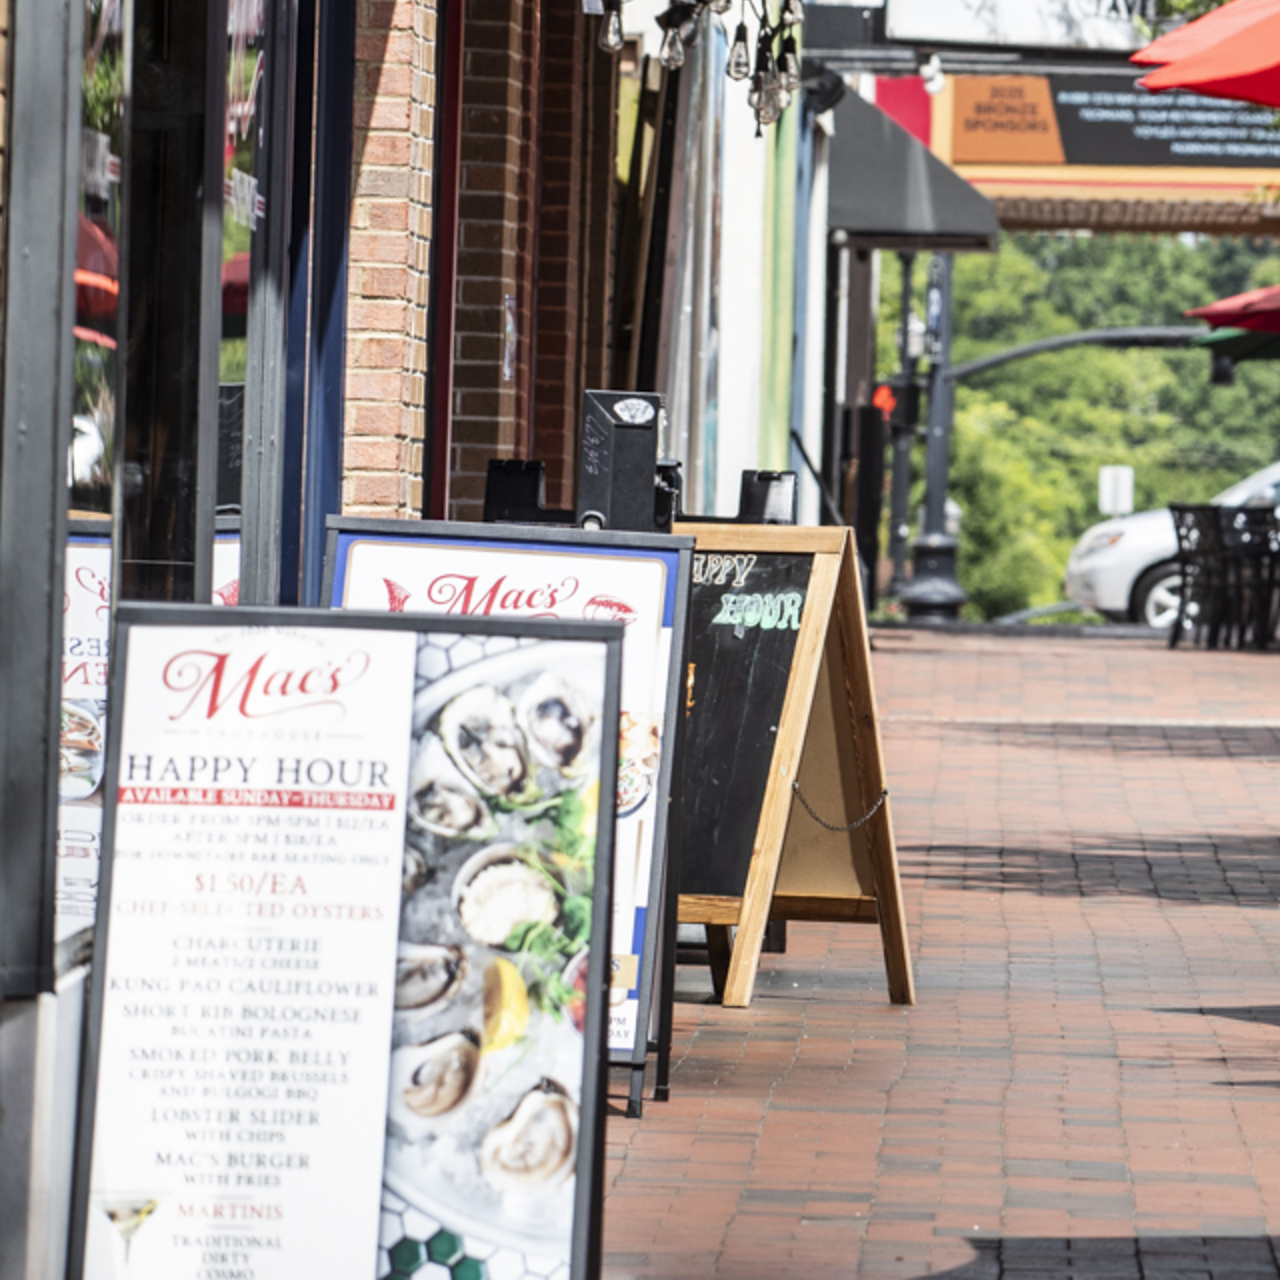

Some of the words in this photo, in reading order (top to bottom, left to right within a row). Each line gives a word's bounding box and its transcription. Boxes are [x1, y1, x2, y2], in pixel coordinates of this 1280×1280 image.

[974, 102, 1039, 117] BRONZE
[964, 118, 1050, 134] SPONSORS
[712, 591, 802, 630] HOUR
[163, 649, 371, 721] Mac's
[127, 754, 257, 784] HAPPY
[276, 757, 390, 788] HOUR
[122, 788, 217, 804] AVAILABLE
[190, 813, 240, 827] FROM
[172, 832, 228, 845] AFTER
[195, 873, 308, 896] $1.50/EA
[291, 902, 385, 919] OYSTERS
[172, 936, 324, 953] CHARCUTERIE
[110, 977, 171, 993] KUNG
[180, 978, 222, 993] PAO
[229, 978, 380, 998] CAULIFLOWER
[122, 1004, 190, 1019] SHORT
[240, 1005, 363, 1023] BOLOGNESE
[260, 1026, 313, 1040] PASTA
[129, 1047, 217, 1063] SMOKED
[224, 1048, 279, 1064] PORK
[288, 1050, 352, 1066] BELLY
[159, 1086, 195, 1098] AND
[151, 1108, 241, 1124] LOBSTER
[249, 1109, 321, 1126] SLIDER
[185, 1129, 232, 1142] WITH
[237, 1129, 286, 1144] CHIPS
[226, 1152, 311, 1169] BURGER
[183, 1173, 231, 1186] WITH
[176, 1202, 285, 1221] MARTINIS
[172, 1235, 284, 1250] TRADITIONAL
[201, 1251, 252, 1266] DIRTY
